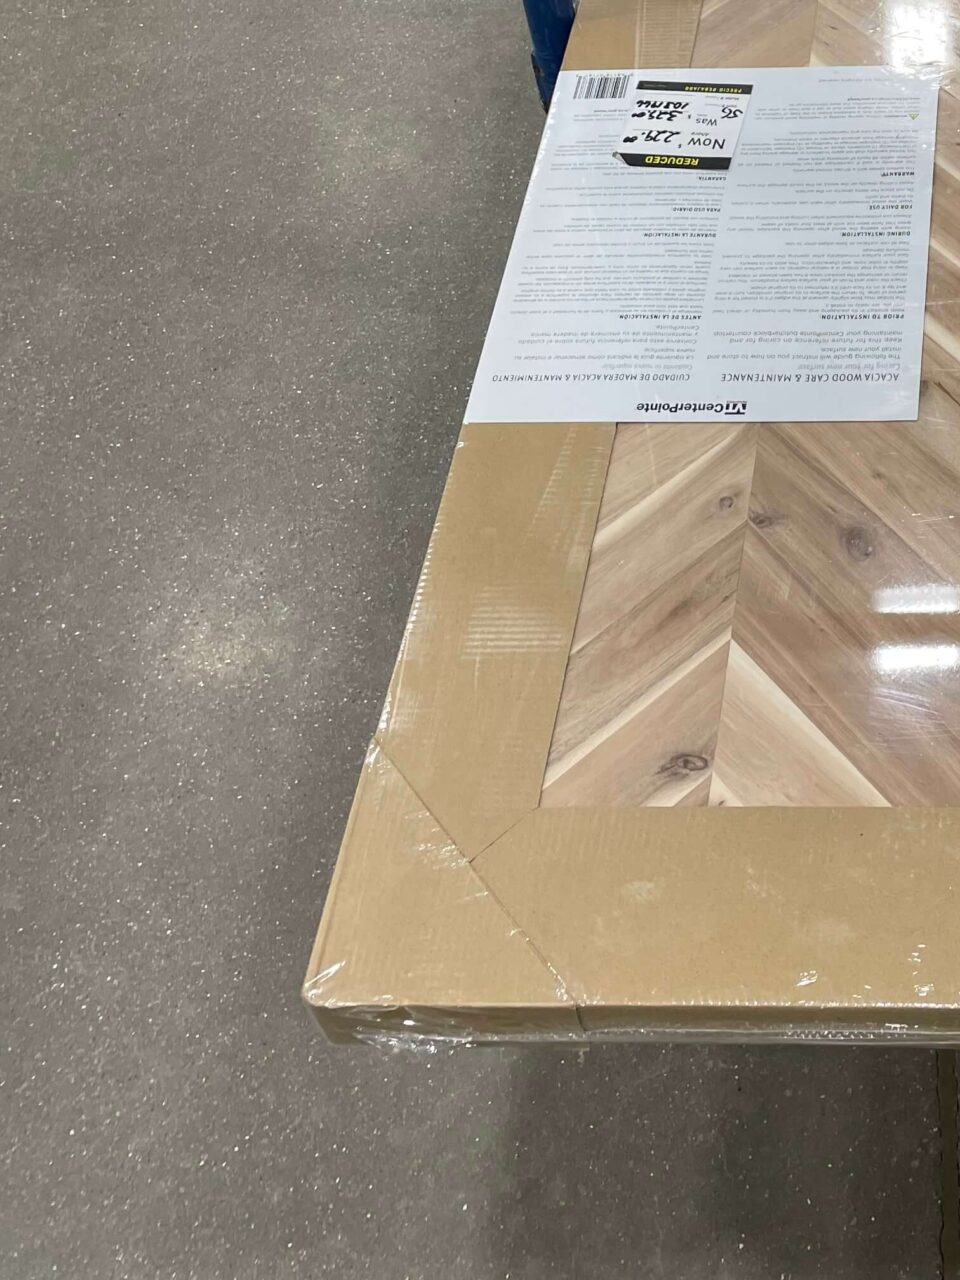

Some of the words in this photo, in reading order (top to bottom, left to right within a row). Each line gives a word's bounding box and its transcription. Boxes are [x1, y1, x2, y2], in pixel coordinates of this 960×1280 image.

[696, 118, 718, 126] Was
[687, 138, 726, 149] Now
[645, 156, 699, 165] REDUCED
[492, 374, 562, 382] MANTENIMIENTO
[652, 373, 690, 381] CUIDADO
[721, 373, 792, 381] MAINTENANCE
[805, 374, 829, 382] CARE
[832, 373, 861, 381] WOOD
[865, 373, 899, 381] ACACIA
[637, 403, 723, 413] CenterPointe
